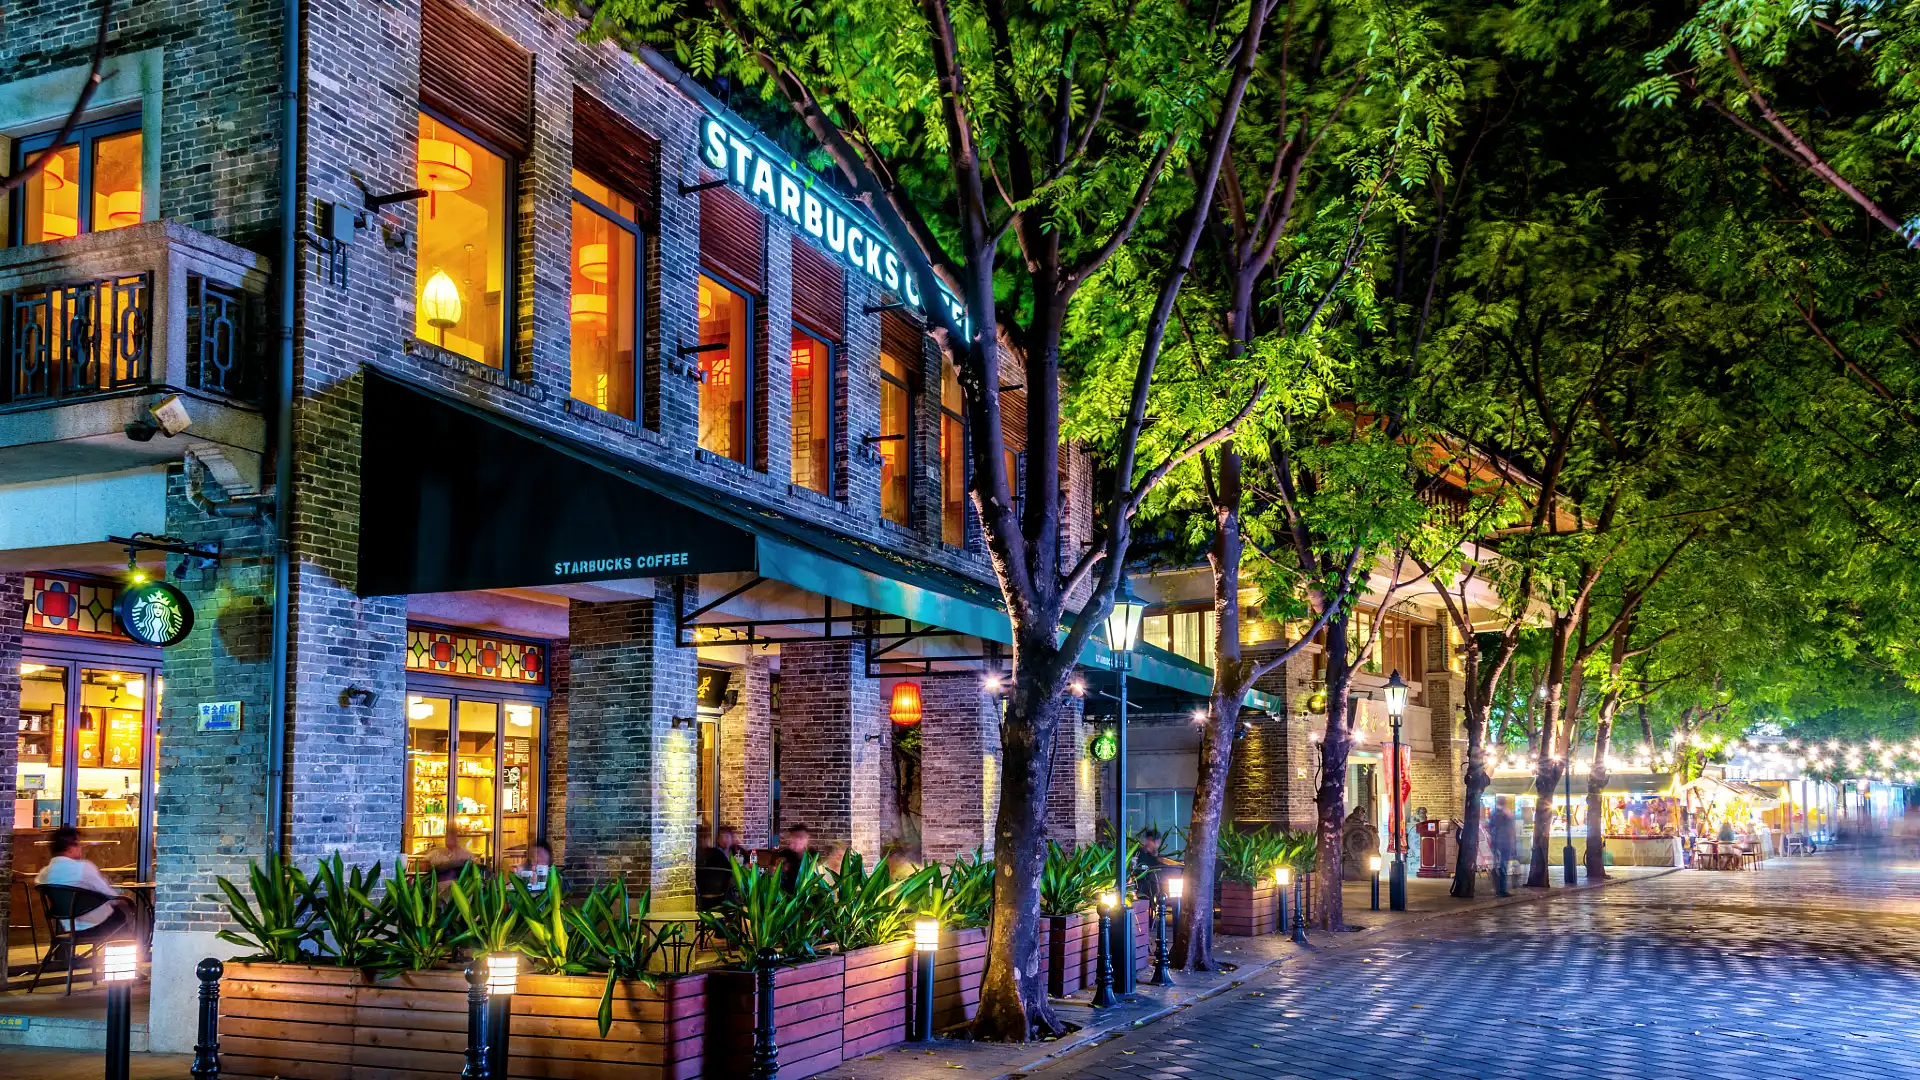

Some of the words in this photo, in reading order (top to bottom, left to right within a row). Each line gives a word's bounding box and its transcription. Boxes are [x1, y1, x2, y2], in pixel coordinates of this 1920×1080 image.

[706, 120, 899, 290] STARBUCKS
[554, 557, 632, 575] STARBUCKS
[637, 552, 689, 568] COFFEE
